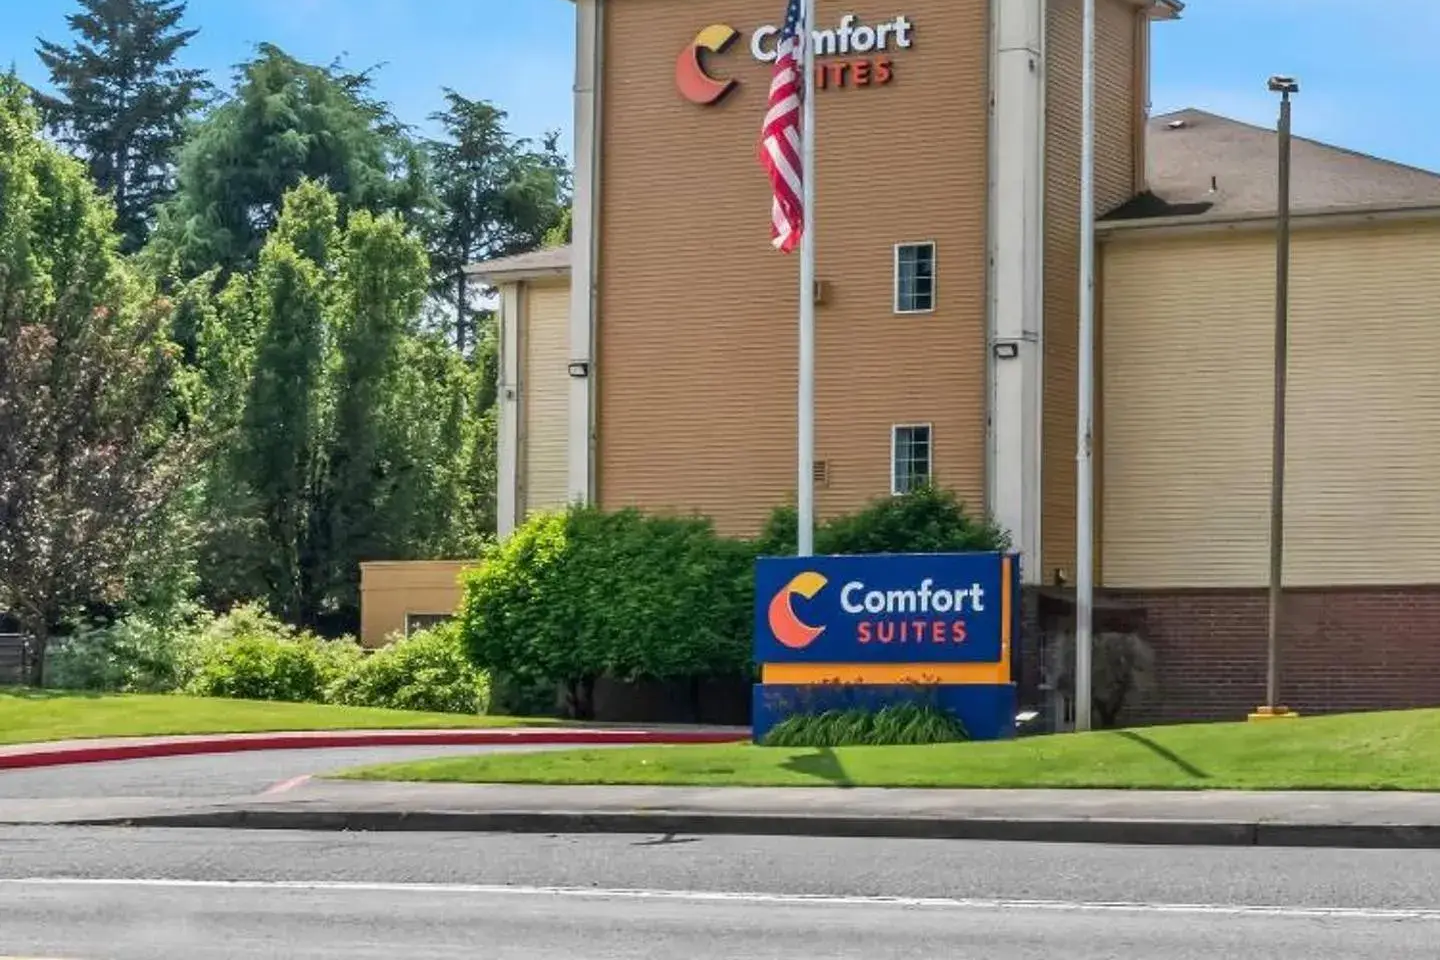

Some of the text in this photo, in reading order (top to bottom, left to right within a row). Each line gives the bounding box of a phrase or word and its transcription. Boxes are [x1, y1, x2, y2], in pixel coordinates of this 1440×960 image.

[751, 15, 911, 61] Cmfort
[840, 578, 984, 614] Comfort
[857, 620, 967, 643] SUITES
